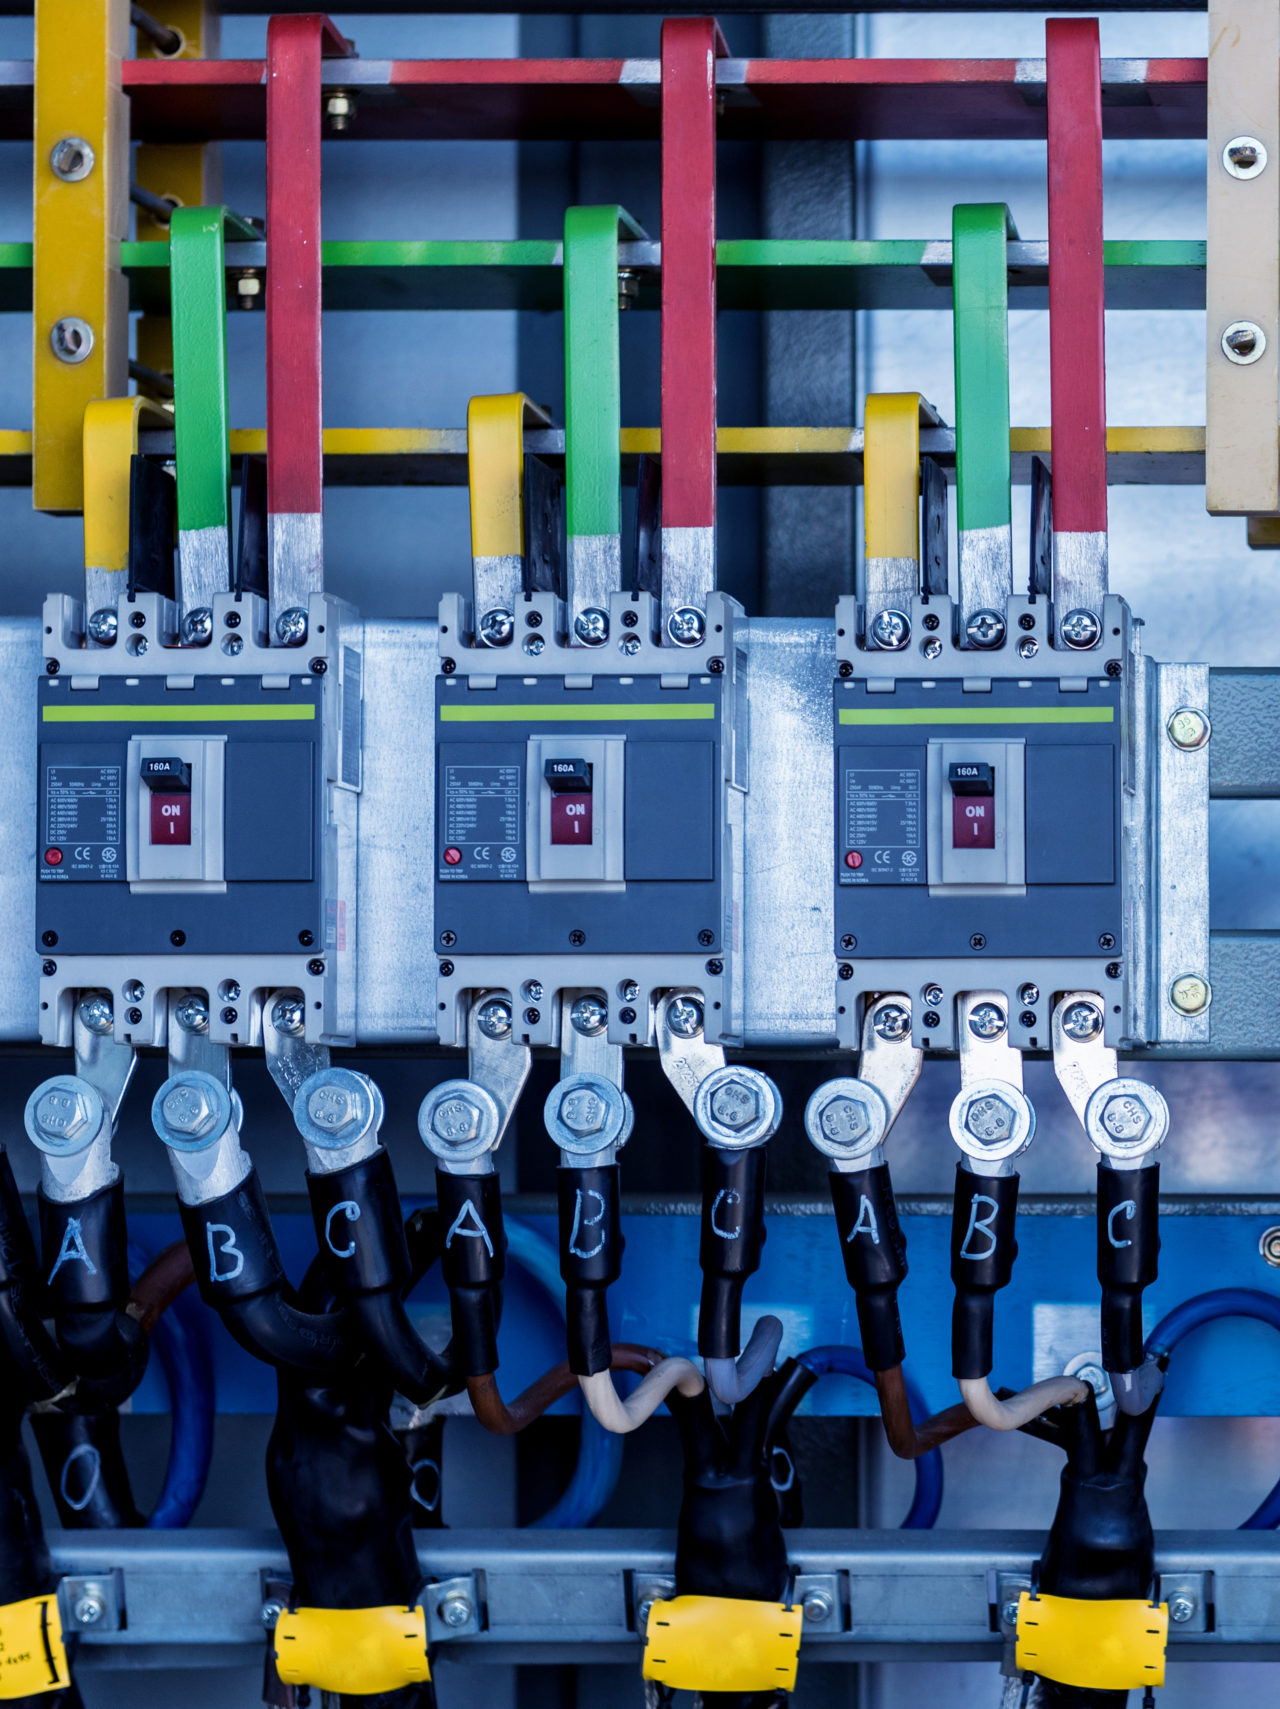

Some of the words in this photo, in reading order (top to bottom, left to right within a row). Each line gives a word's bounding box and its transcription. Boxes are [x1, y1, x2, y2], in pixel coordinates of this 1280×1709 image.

[149, 763, 170, 771] 160A
[553, 764, 574, 772] 160A
[162, 805, 180, 816] ON
[566, 804, 585, 815] ON
[966, 806, 985, 817] ON
[75, 847, 90, 860] CE
[474, 847, 490, 860] CE
[874, 851, 890, 863] CE
[326, 1200, 361, 1257] C
[446, 1199, 494, 1258] A
[570, 1189, 605, 1258] B
[712, 1189, 741, 1239] C
[847, 1194, 880, 1244] A
[960, 1194, 999, 1260] B
[1108, 1200, 1136, 1248] C
[48, 1217, 98, 1284] A
[207, 1222, 247, 1281] B
